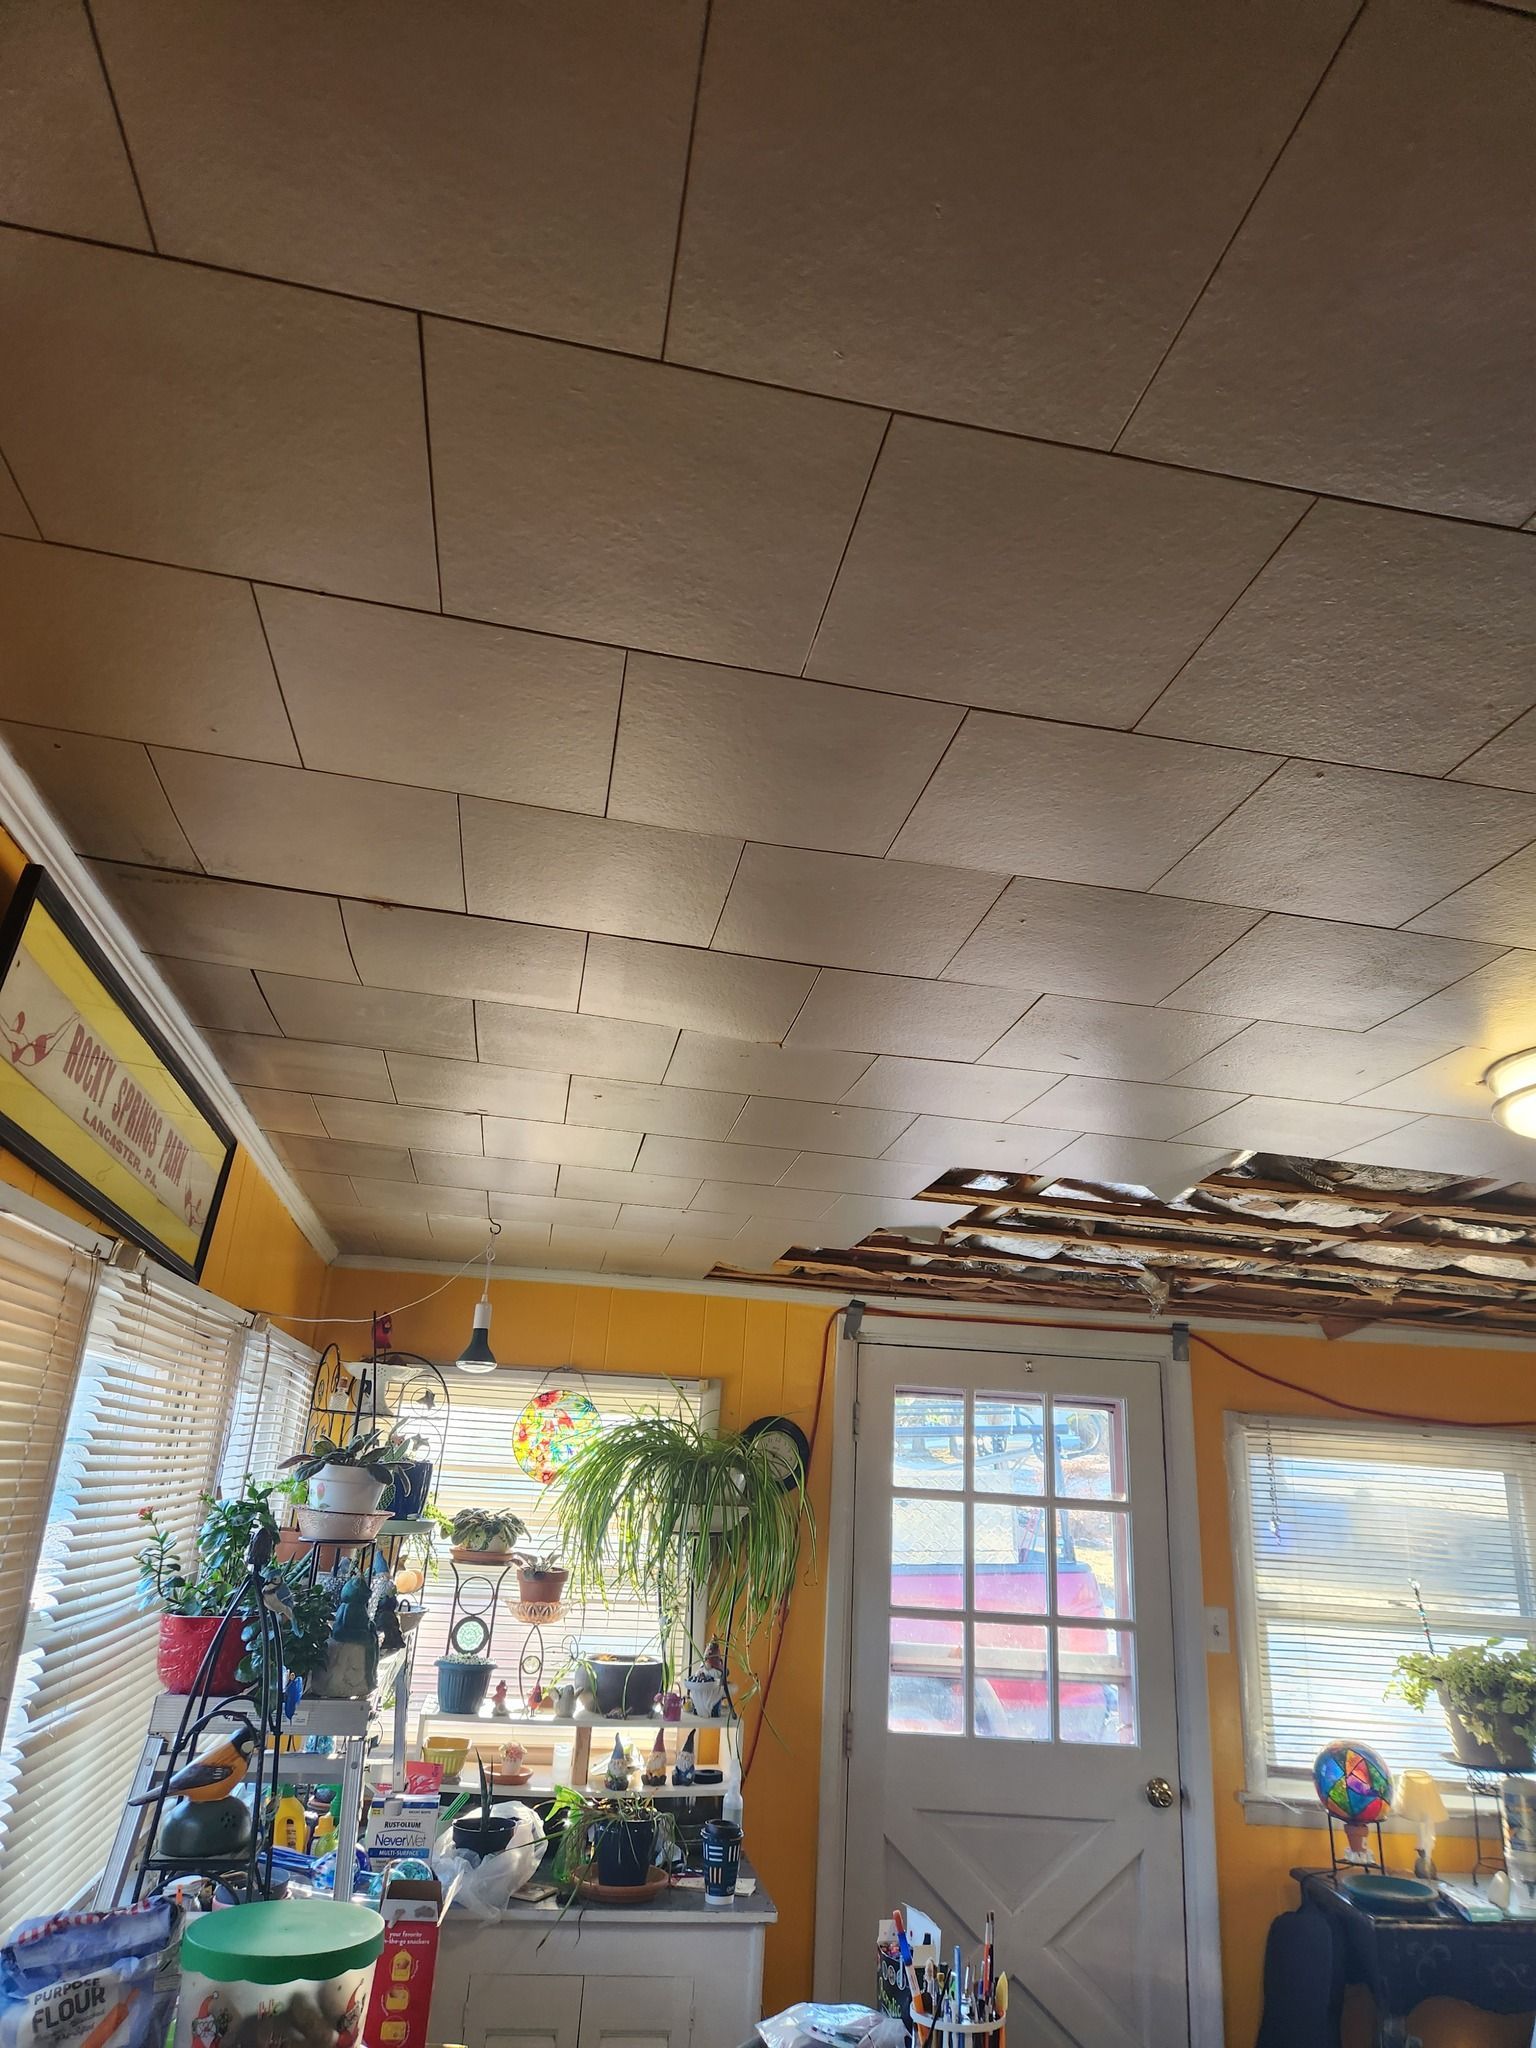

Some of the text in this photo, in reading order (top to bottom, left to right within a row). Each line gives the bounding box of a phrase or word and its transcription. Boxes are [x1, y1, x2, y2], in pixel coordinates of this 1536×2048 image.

[63, 1023, 190, 1187] ROCKY SPRINGS PARK
[83, 1107, 158, 1189] LANCASTER, PA.
[375, 1833, 426, 1847] NeverWet
[378, 1849, 418, 1857] MULTI-SURFACE
[402, 1930, 423, 1938] favorite
[32, 1986, 106, 2034] FLOUR
